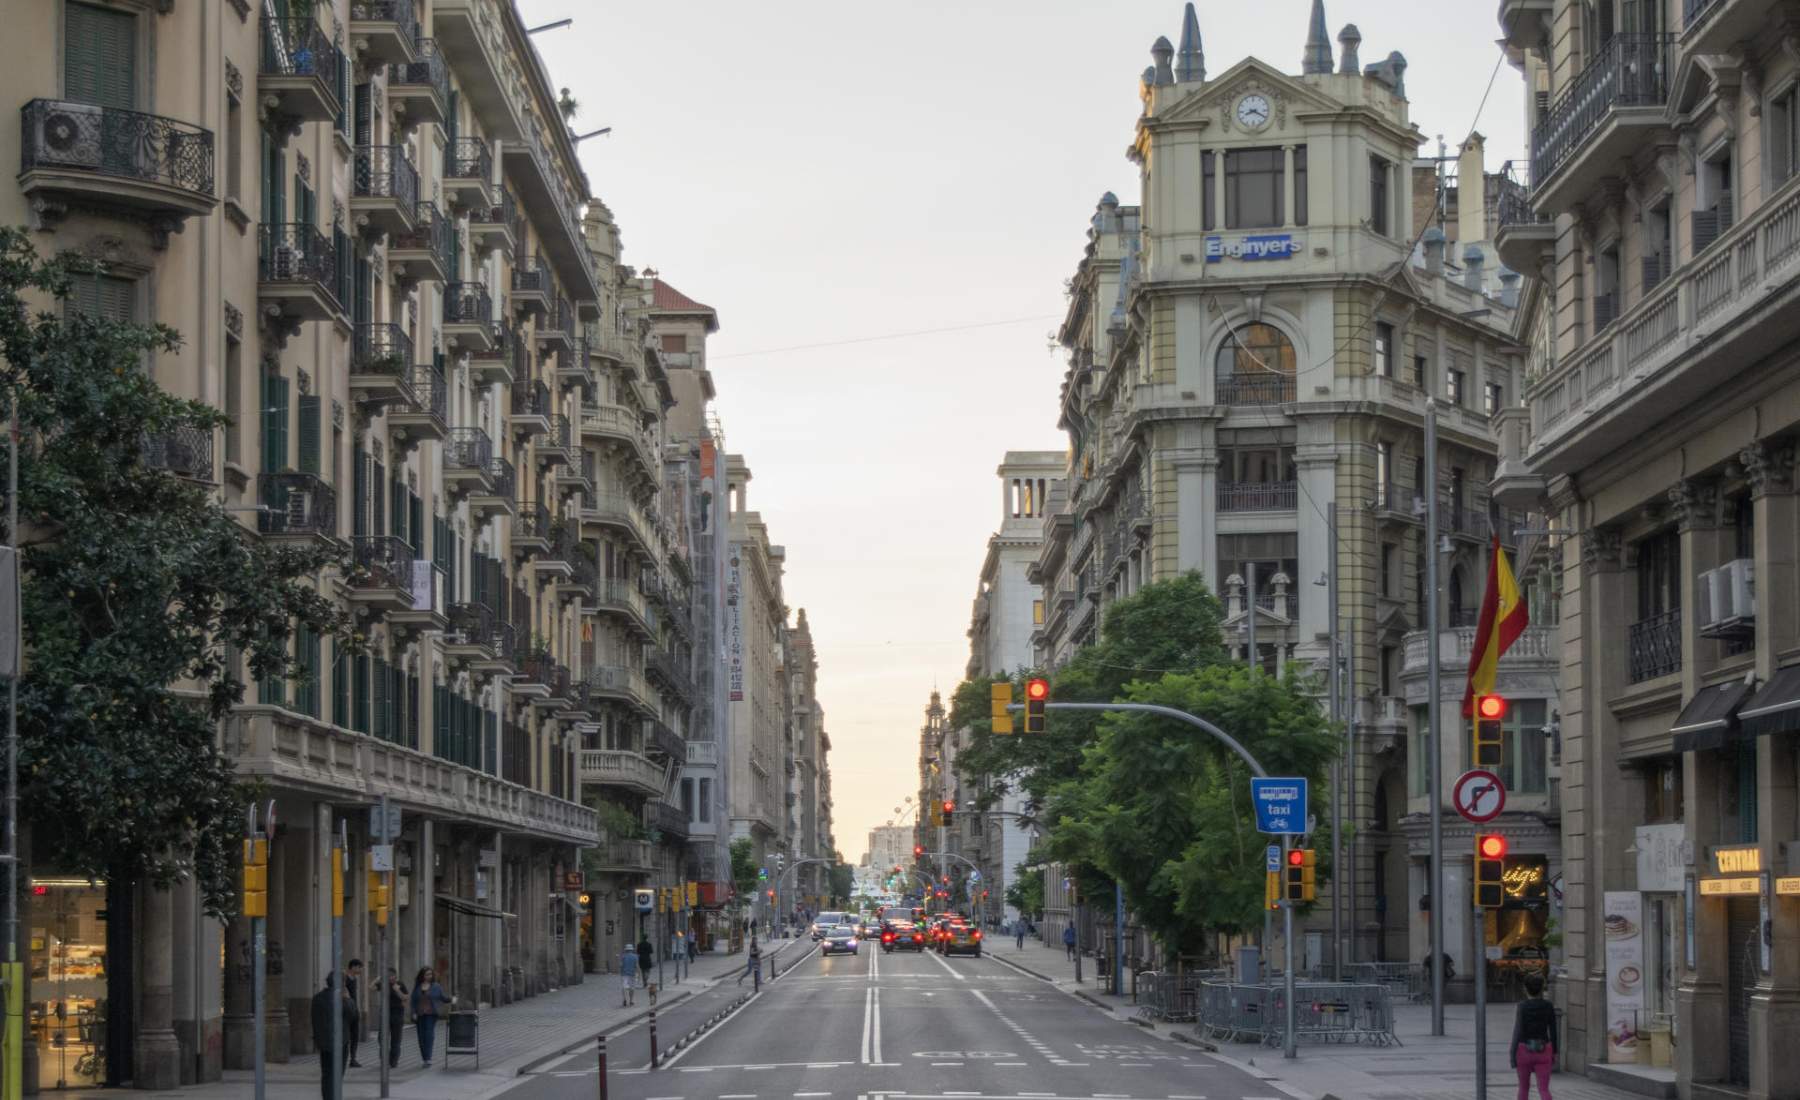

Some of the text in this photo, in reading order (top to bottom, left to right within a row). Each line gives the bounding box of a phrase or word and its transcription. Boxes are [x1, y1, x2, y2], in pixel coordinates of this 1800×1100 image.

[1206, 236, 1302, 258] Enginyers
[1268, 804, 1290, 815] taxi
[1502, 866, 1543, 893] uigi
